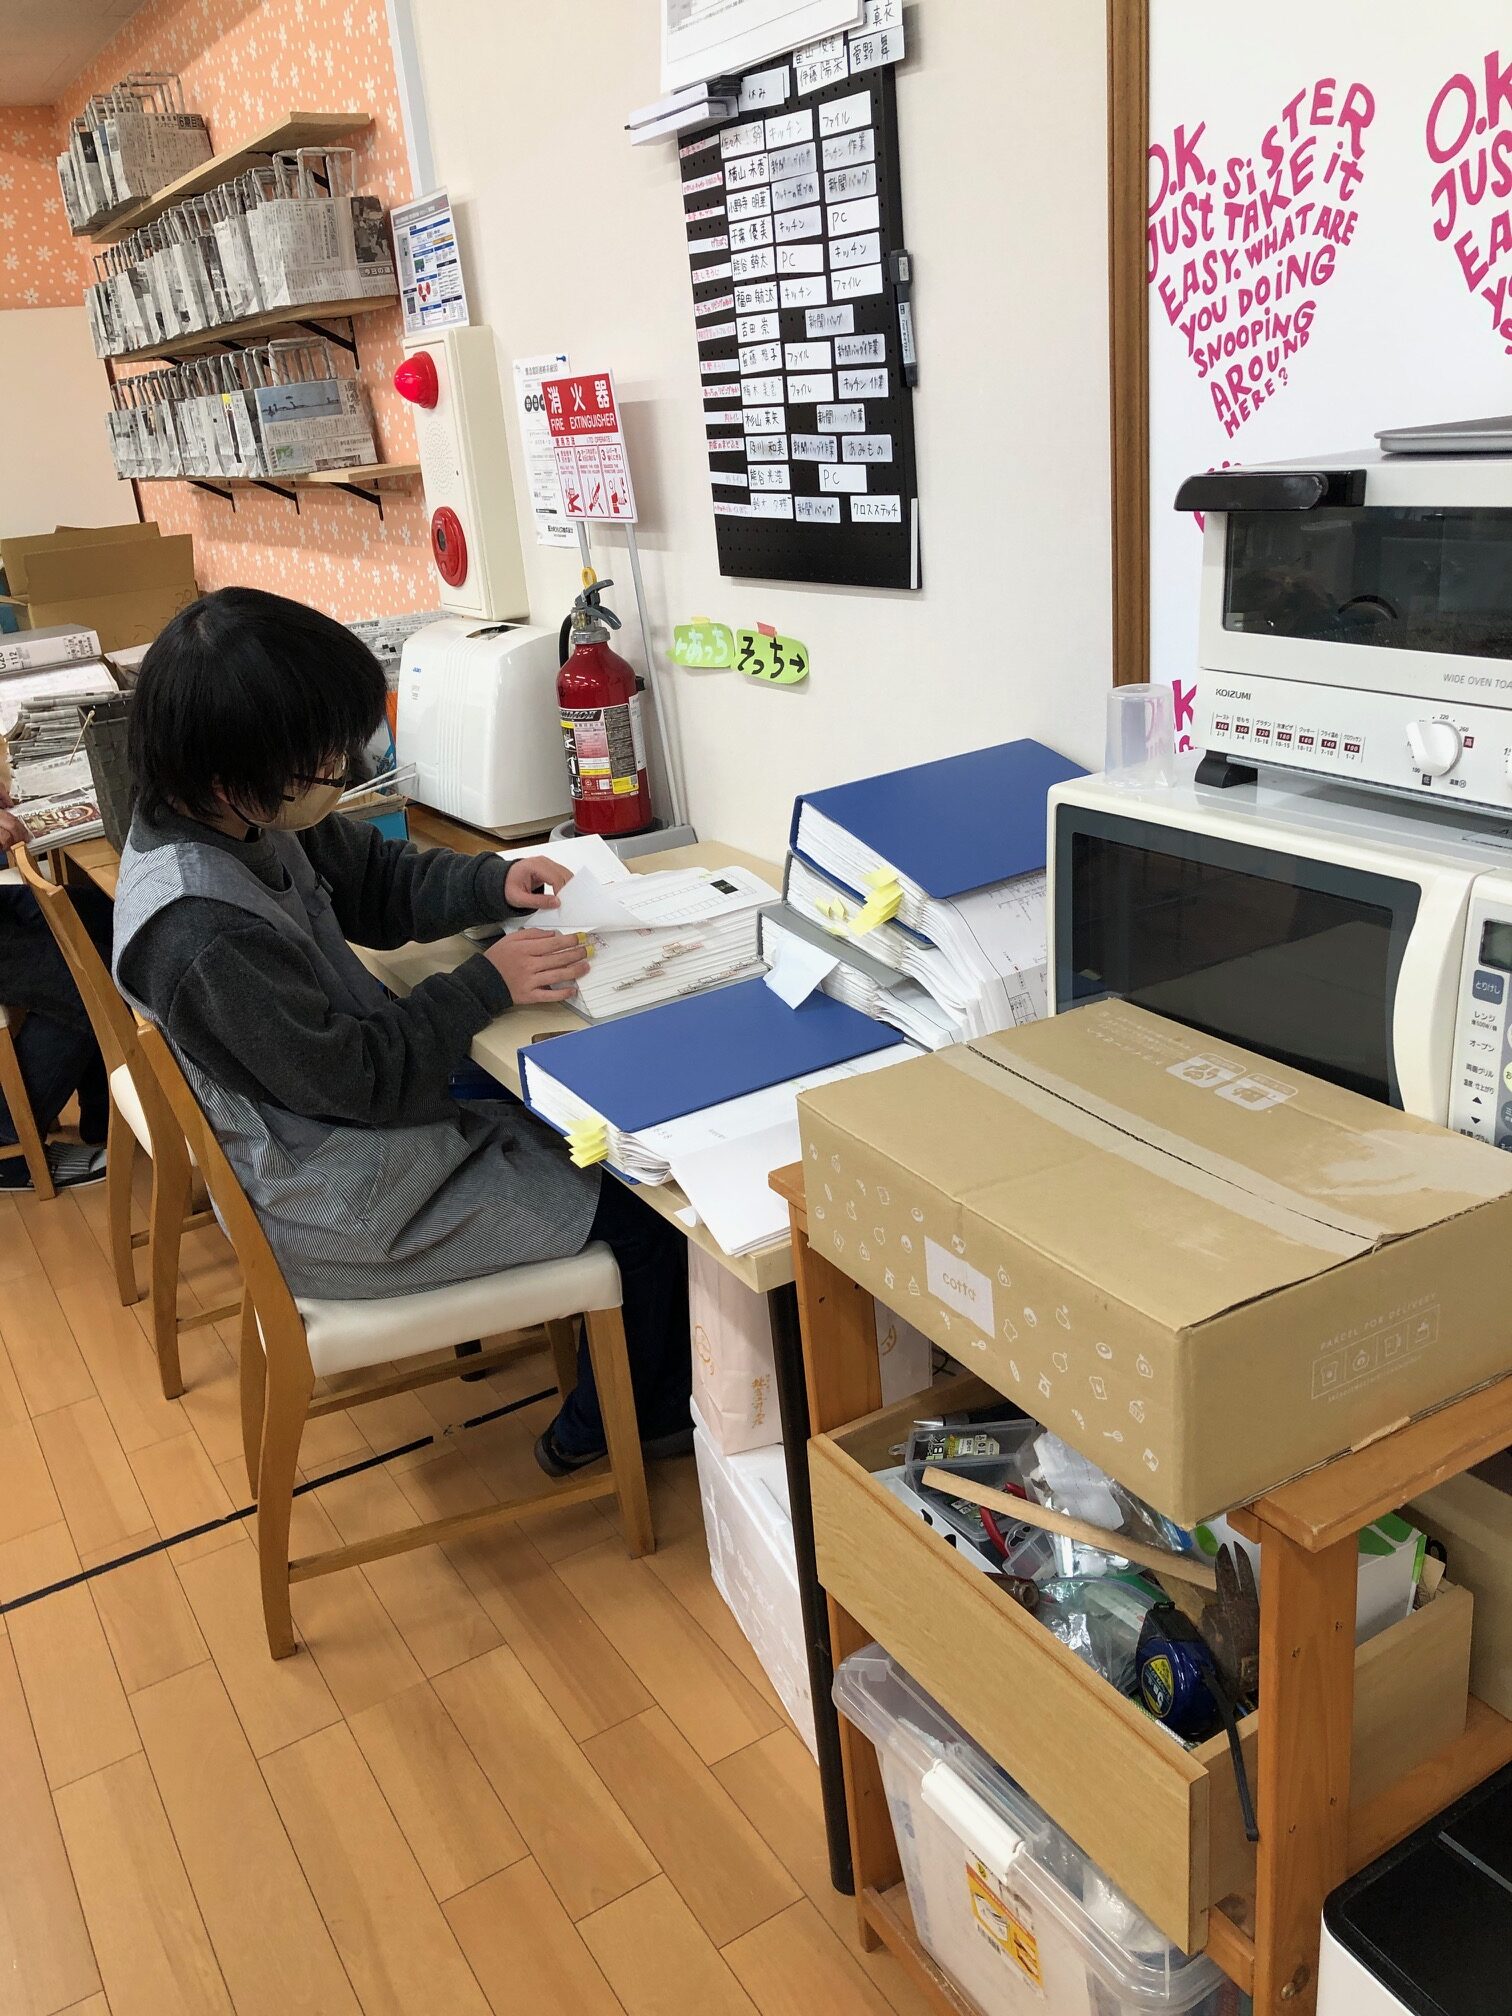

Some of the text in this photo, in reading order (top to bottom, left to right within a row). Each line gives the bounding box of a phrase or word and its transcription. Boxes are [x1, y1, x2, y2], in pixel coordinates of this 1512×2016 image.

[822, 111, 850, 128] ファイル
[1224, 136, 1316, 242] TAKE
[779, 218, 804, 233] キッチン
[832, 211, 848, 232] PC
[1245, 202, 1314, 269] WHAT
[1313, 206, 1358, 246] ARE
[834, 242, 867, 258] キッチン
[782, 251, 796, 269] PC
[833, 276, 861, 291] ファイル
[785, 286, 812, 300] キッチン
[1179, 296, 1227, 357] YOU
[1211, 331, 1309, 421] AROUND
[547, 379, 610, 414] 消火器
[1224, 367, 1288, 438] HERE?
[550, 413, 616, 431] FIRE EXTINGUISHER
[577, 450, 582, 462] 2
[601, 449, 606, 461] 3
[848, 441, 884, 457] あみもの
[823, 469, 840, 488] PC
[853, 503, 899, 517] クロスステッチ
[737, 636, 785, 679] そっち
[1443, 673, 1466, 684] WIDE
[1467, 676, 1492, 687] OVEN
[1215, 688, 1251, 701] KOIZUMI
[1255, 719, 1272, 727] グラタン
[1475, 981, 1500, 995] とりけし
[1474, 1011, 1496, 1022] レンジ
[942, 1272, 976, 1302] cotta
[1320, 1291, 1437, 1351] PARCEL FOR DELIVERY
